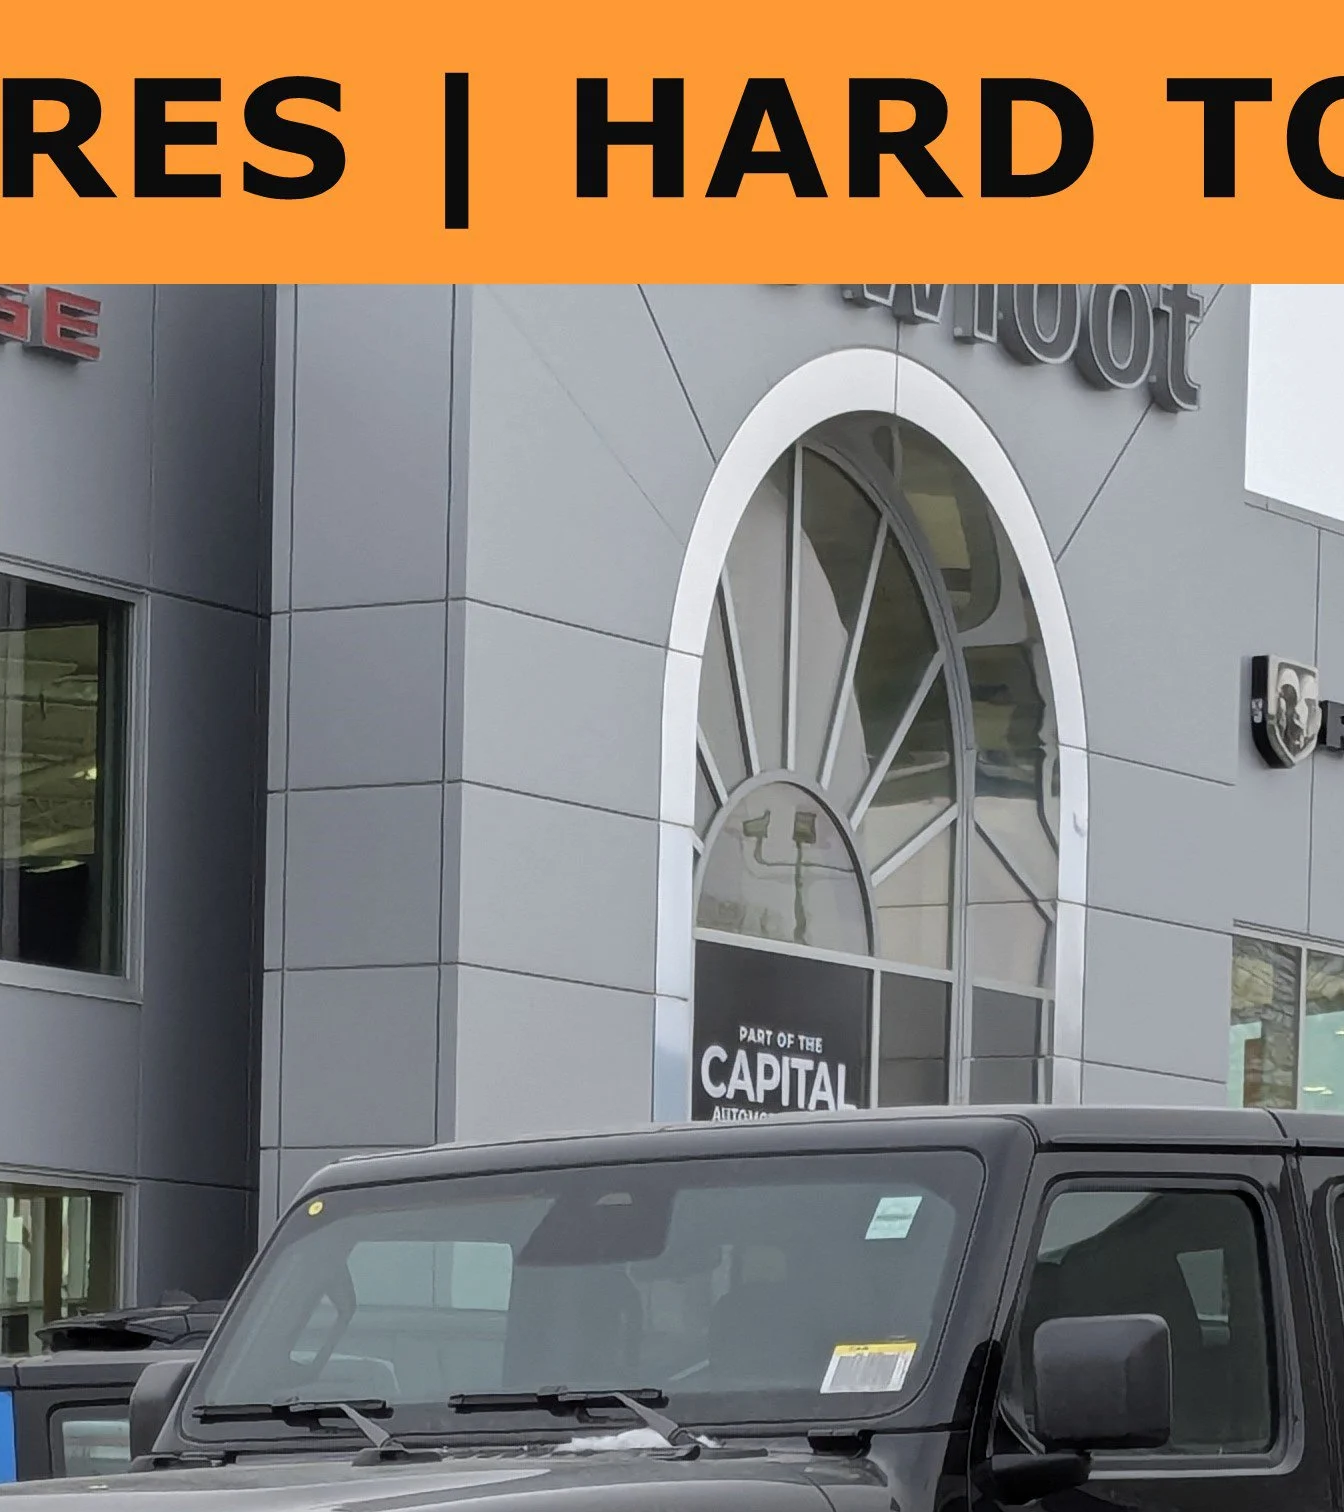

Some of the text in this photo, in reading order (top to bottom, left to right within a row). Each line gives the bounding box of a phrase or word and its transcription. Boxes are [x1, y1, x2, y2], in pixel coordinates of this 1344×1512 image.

[739, 1026, 823, 1053] PART OF THE
[701, 1045, 858, 1111] CAPITAL
